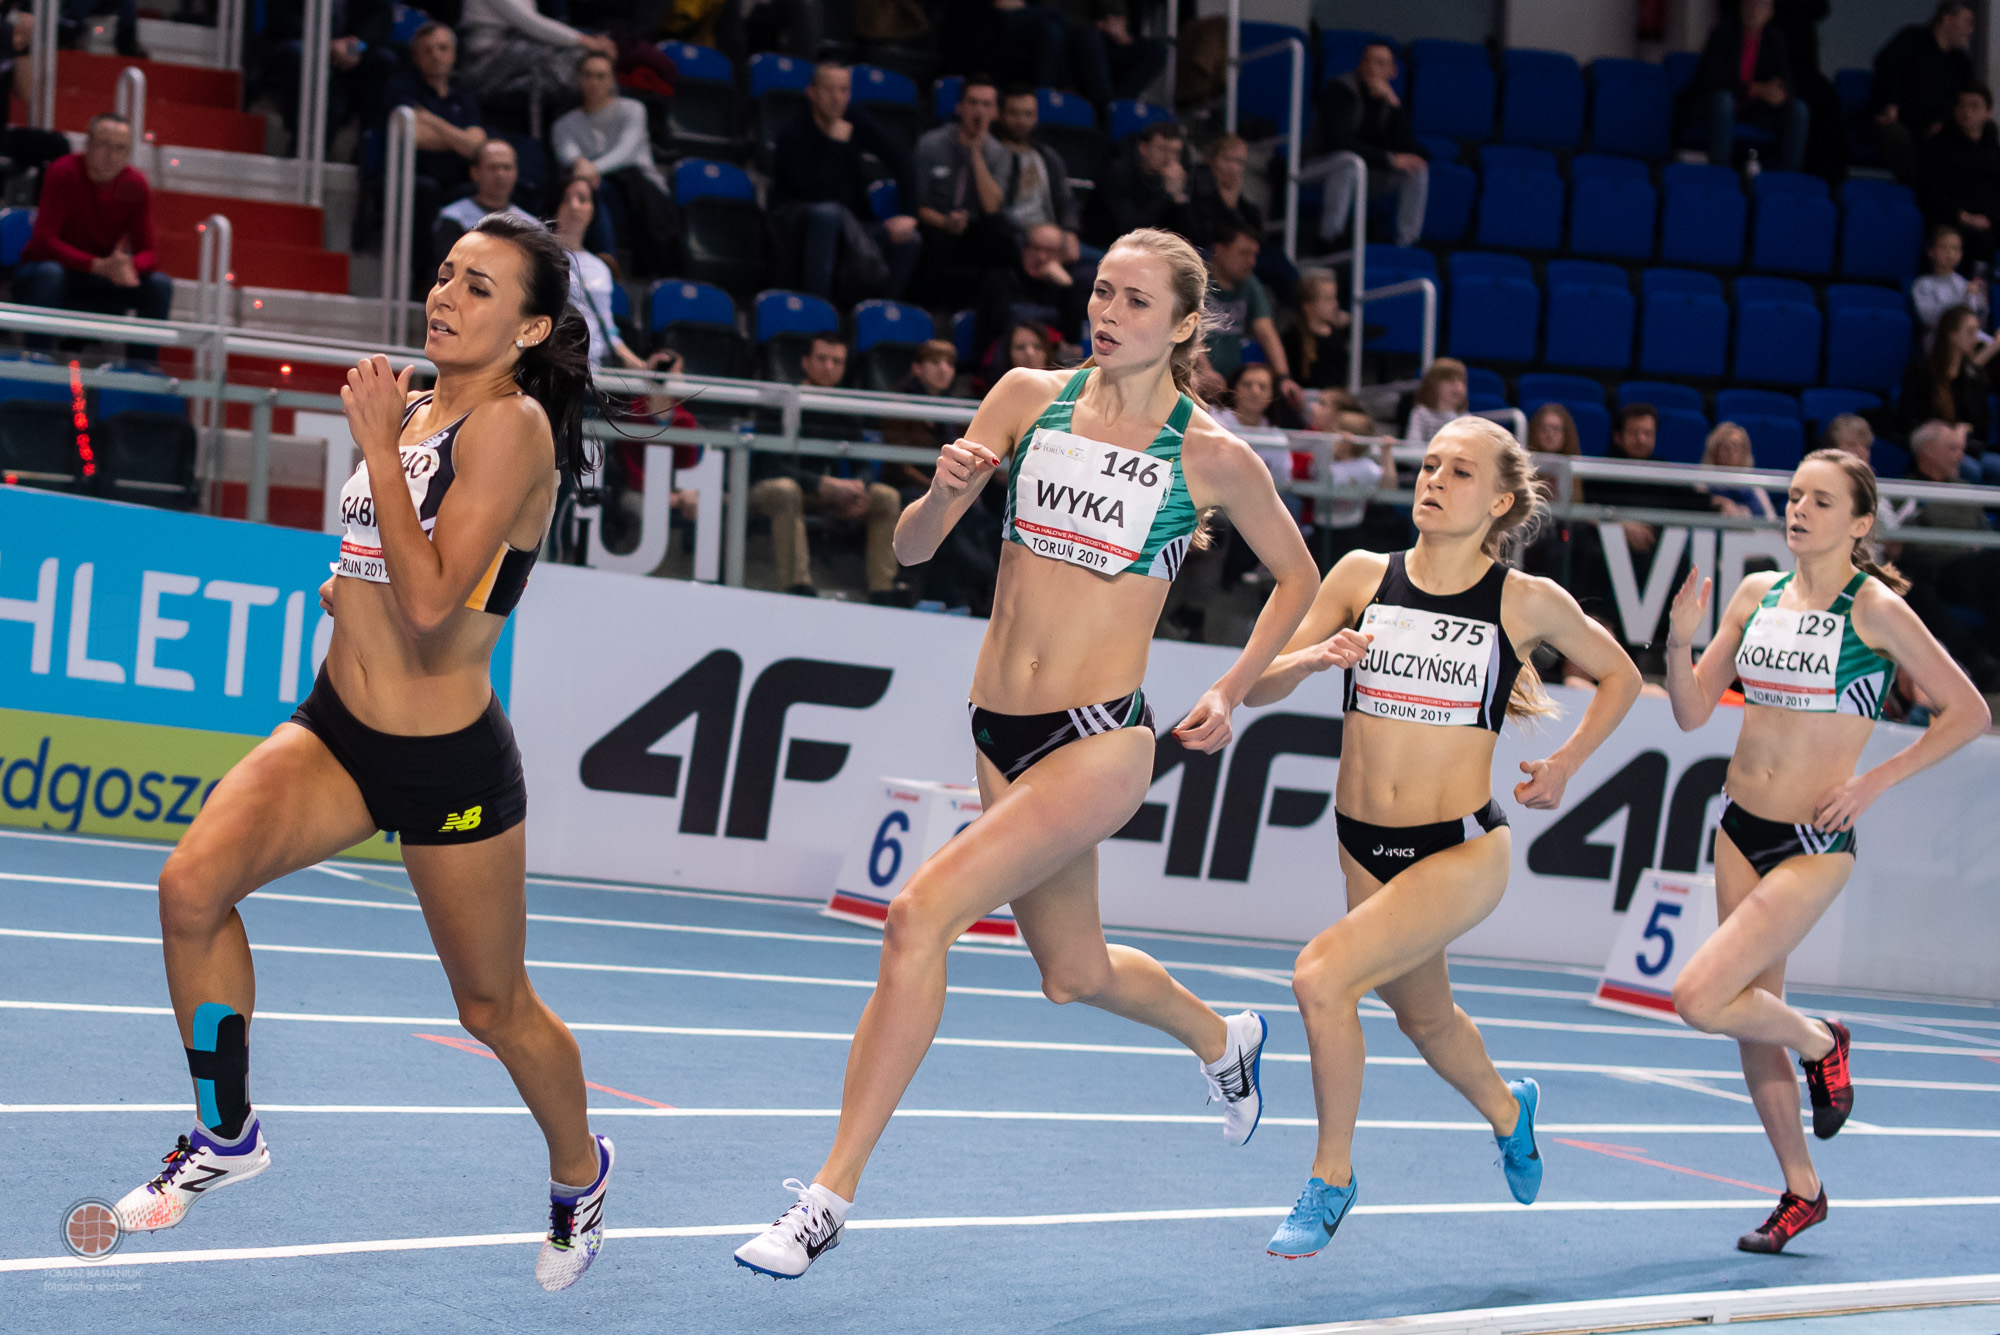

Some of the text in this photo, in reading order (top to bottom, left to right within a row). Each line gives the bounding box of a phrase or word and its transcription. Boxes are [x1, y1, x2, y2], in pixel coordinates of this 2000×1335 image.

[1100, 451, 1160, 488] 146
[341, 496, 377, 527] SAB
[1037, 479, 1124, 528] WYKA
[1032, 537, 1108, 568] TORUŃ 2019
[1040, 527, 1066, 539] HALOWE
[1068, 533, 1110, 551] MISTRZOSTWA
[1109, 546, 1133, 558] POLSKI
[1431, 619, 1486, 646] 375
[1796, 614, 1837, 637] 129
[1359, 647, 1478, 688] GULCZYŃSKA
[1738, 644, 1831, 675] KOŁECKA
[1374, 702, 1451, 723] TORUŃ 2019
[1785, 696, 1811, 707] 2019
[579, 648, 894, 841] 4F
[0, 736, 223, 832] dgosz
[1107, 711, 1343, 882] 4F
[868, 810, 910, 888] 6
[1636, 901, 1682, 976] 5
